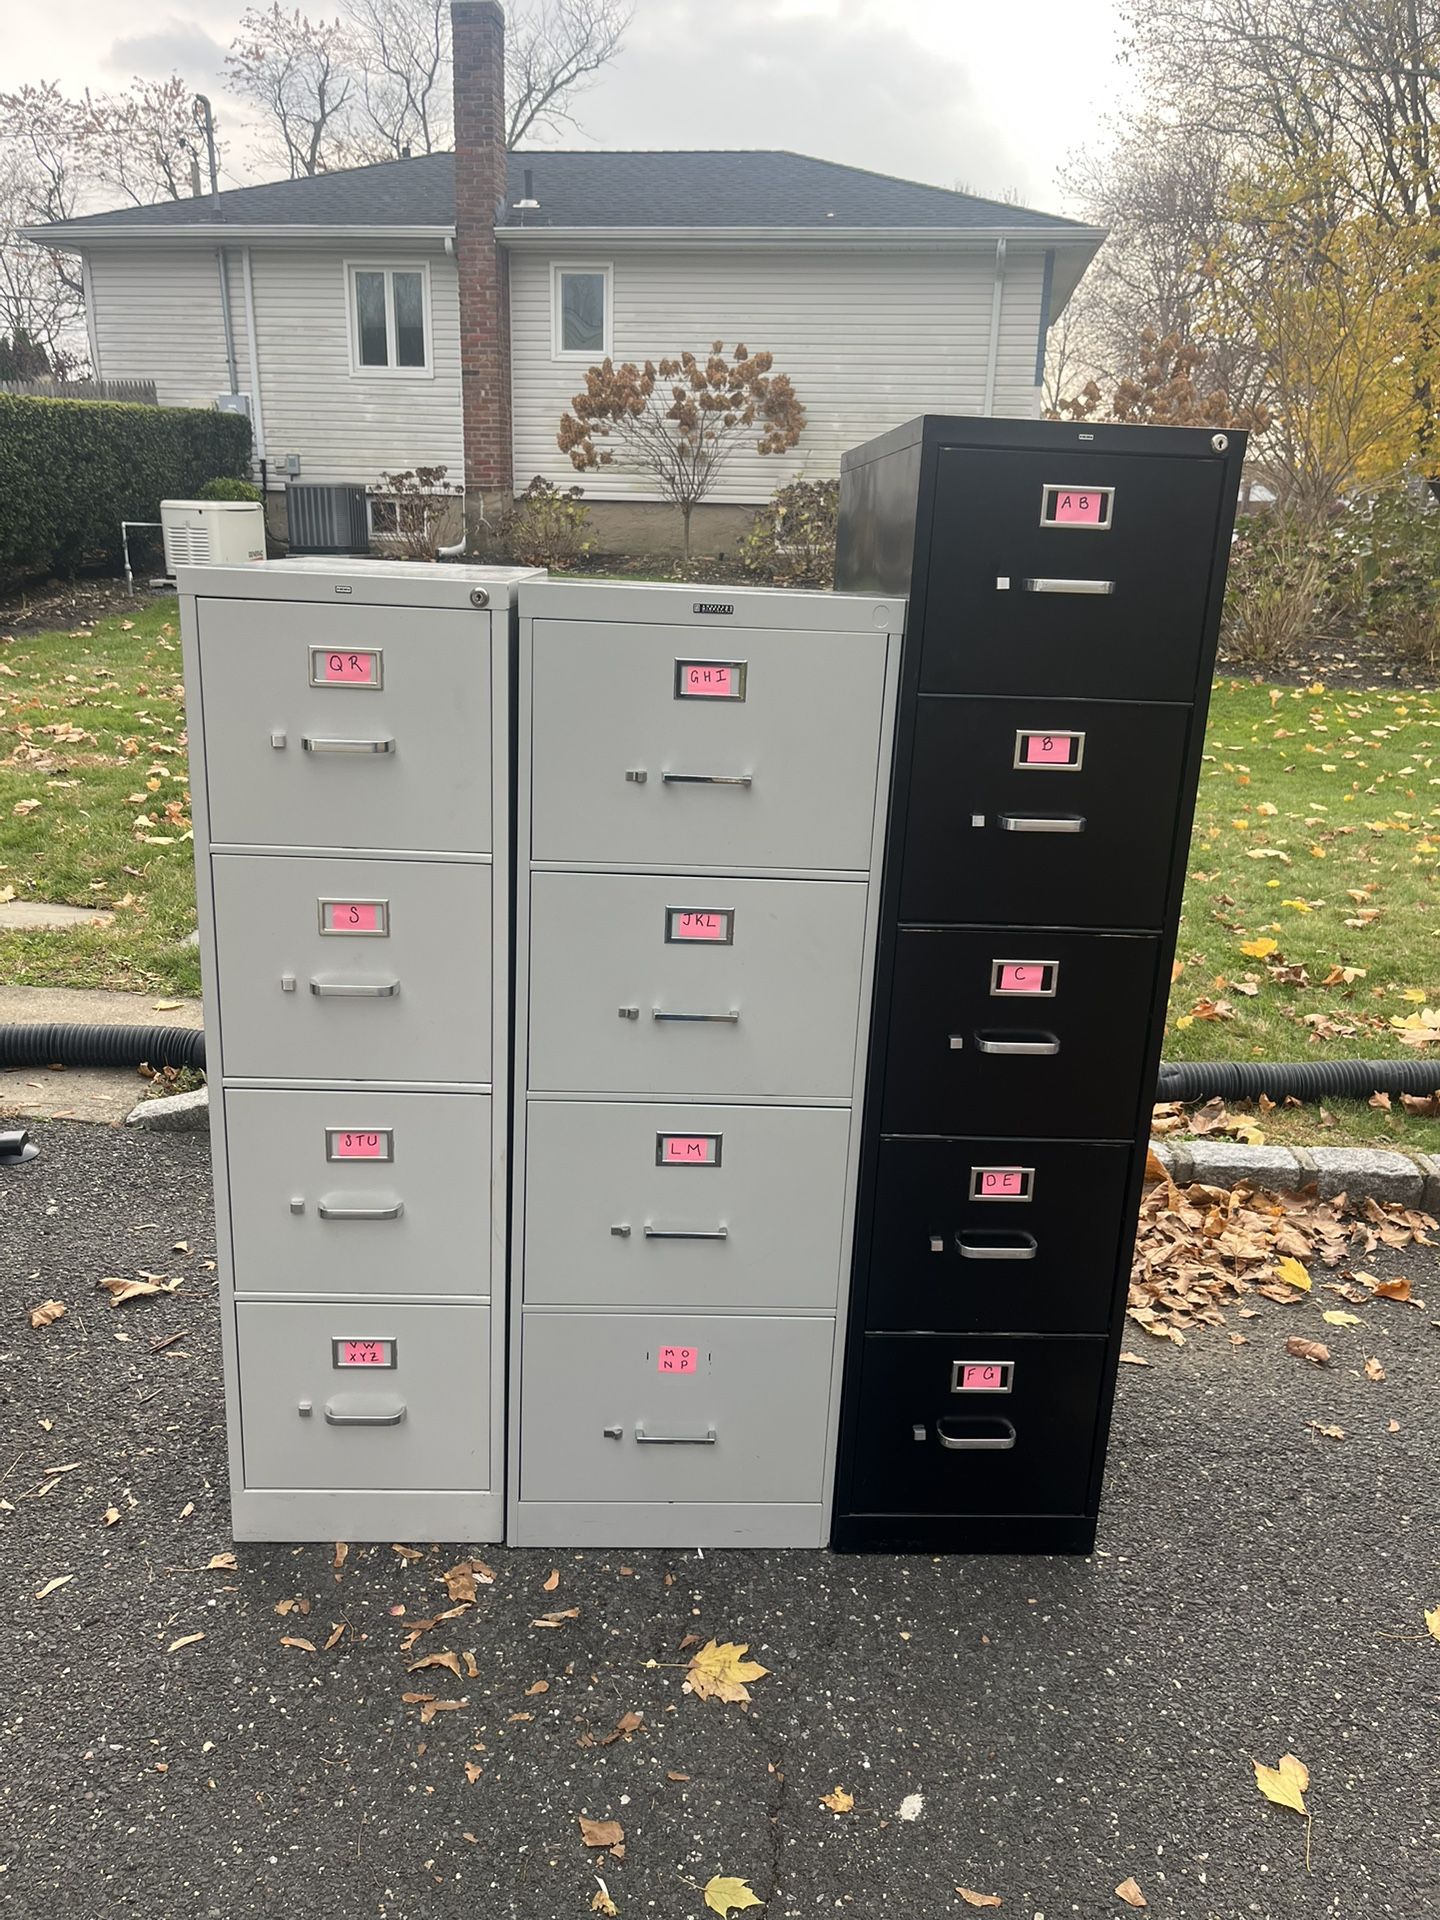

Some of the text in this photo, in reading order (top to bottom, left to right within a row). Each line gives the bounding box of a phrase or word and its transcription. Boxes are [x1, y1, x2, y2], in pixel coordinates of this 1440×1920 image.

[1042, 736, 1053, 751] B
[349, 906, 360, 923] S
[1014, 967, 1025, 980] C
